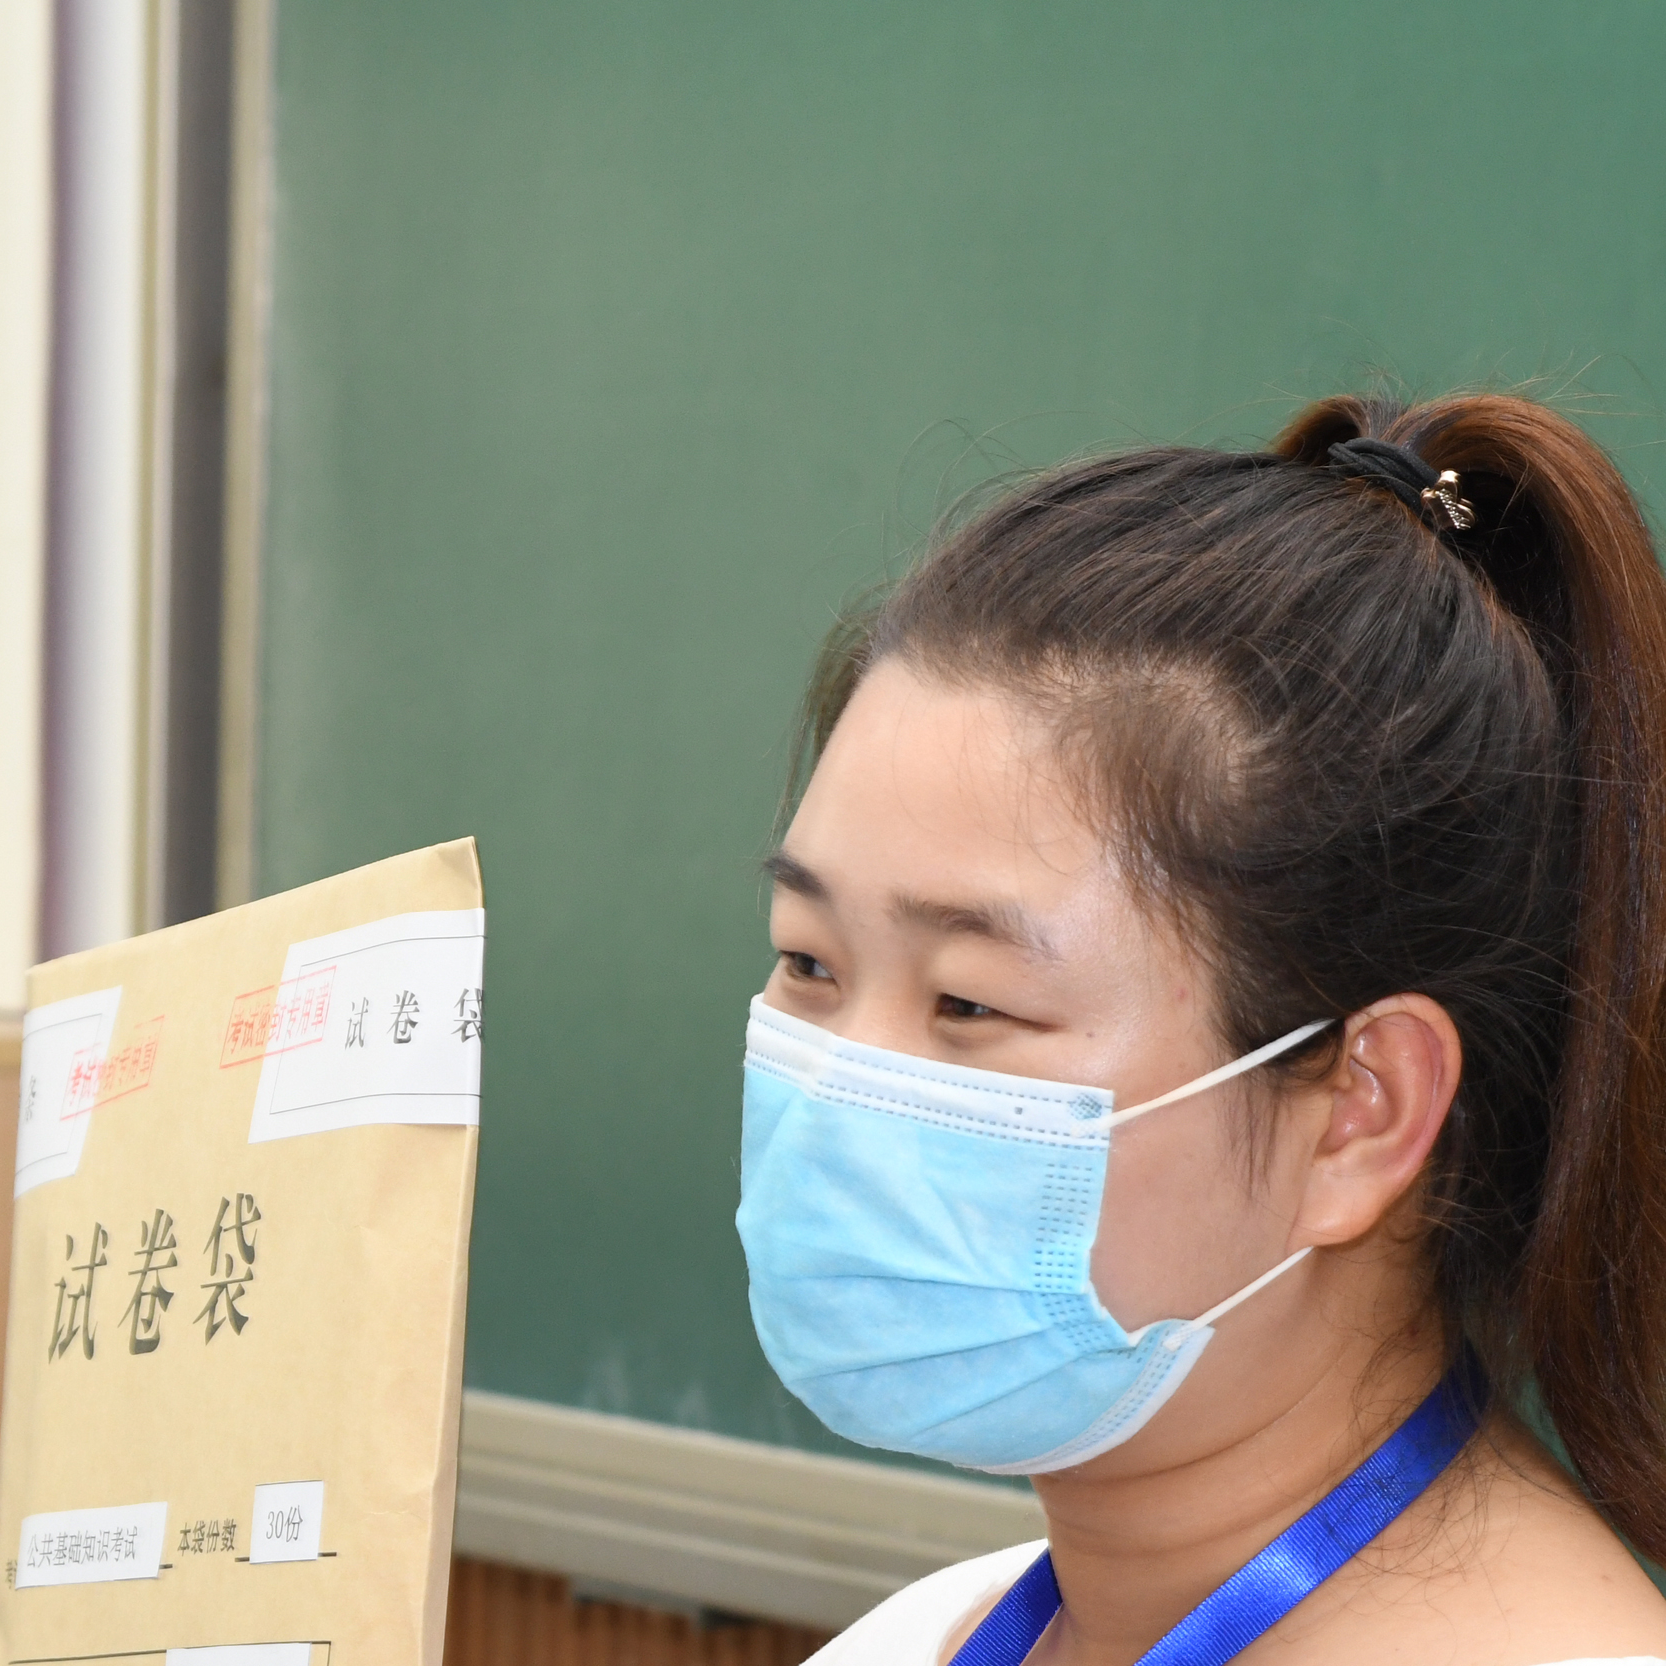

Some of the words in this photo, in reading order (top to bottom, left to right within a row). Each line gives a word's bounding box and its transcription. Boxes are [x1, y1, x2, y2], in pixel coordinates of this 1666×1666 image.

[47, 1192, 263, 1365] 试卷袋
[266, 1505, 304, 1543] 30份
[27, 1525, 139, 1568] 公共基础知识考试
